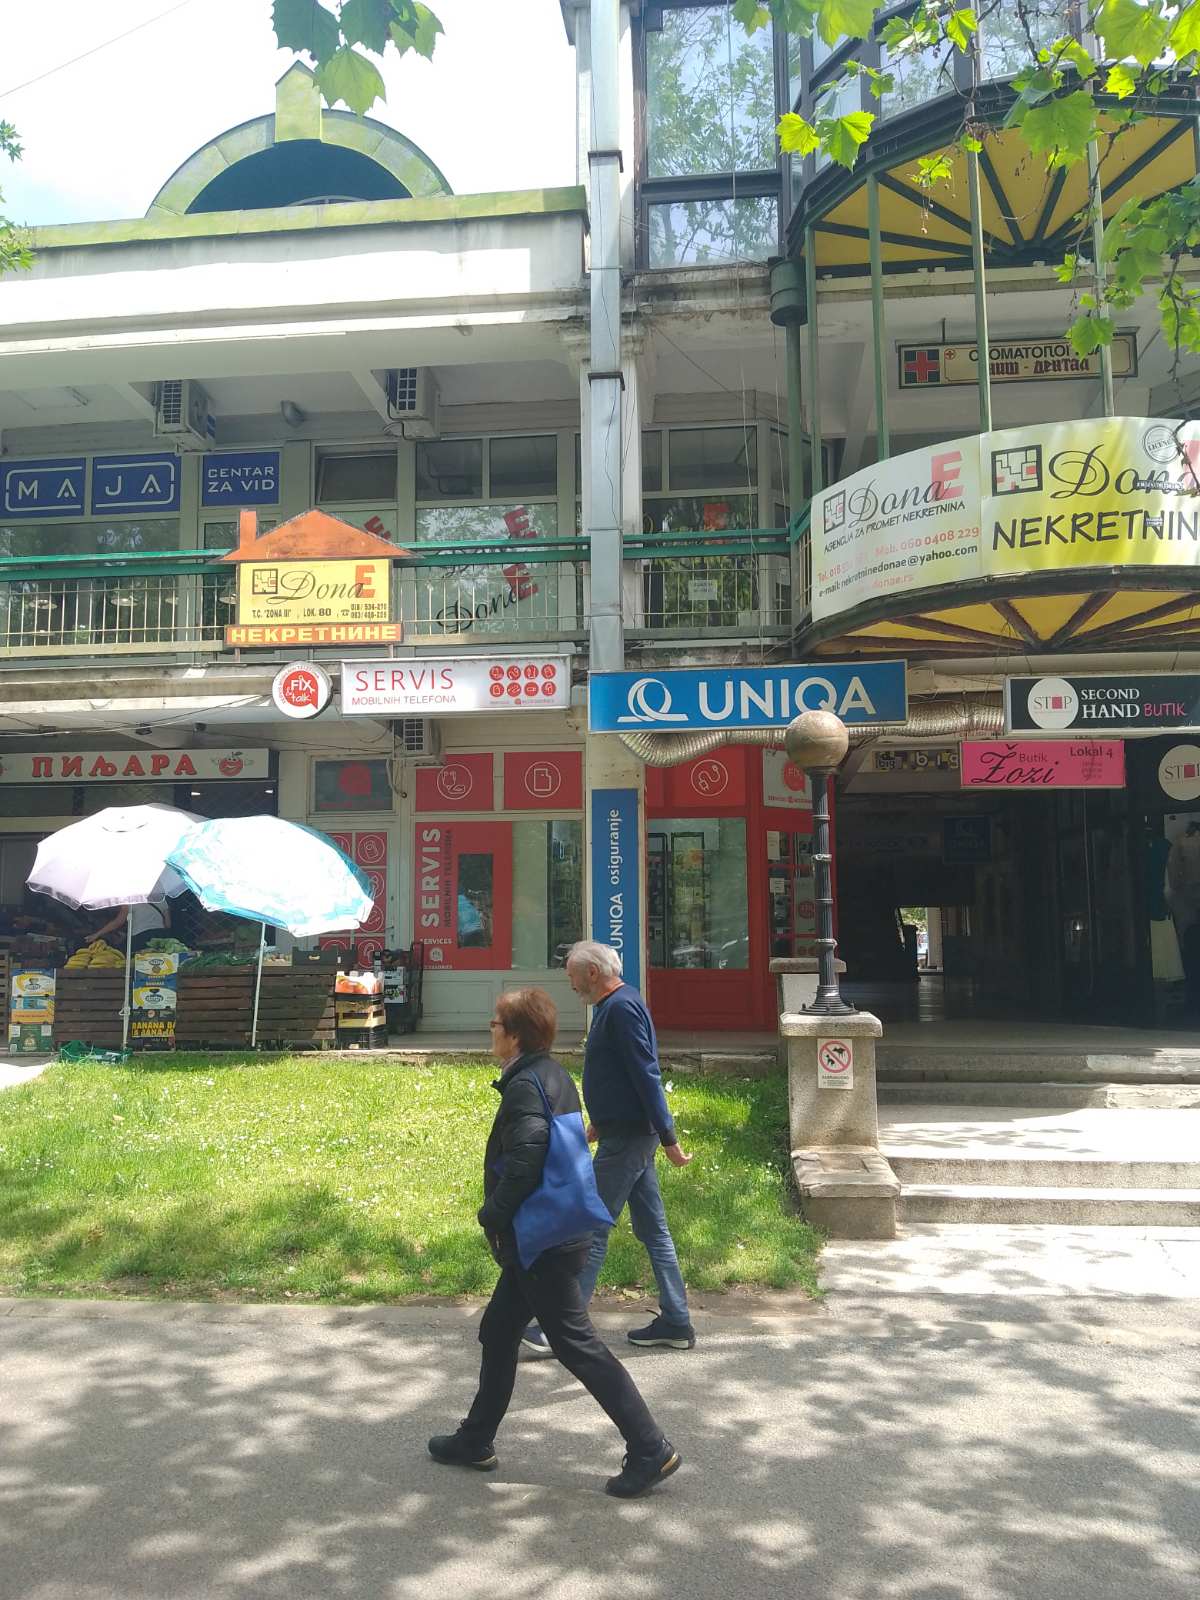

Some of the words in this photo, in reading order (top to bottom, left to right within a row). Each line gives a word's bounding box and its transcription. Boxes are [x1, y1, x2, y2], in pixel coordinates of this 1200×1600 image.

[969, 343, 1102, 362] СОМАТОЛОА
[208, 466, 275, 478] CENTAR
[208, 481, 233, 493] ZA
[241, 479, 275, 492] VID
[848, 479, 951, 528] Dona
[855, 527, 865, 539] ZA
[865, 513, 902, 537] PROMET
[902, 500, 965, 524] NEKRETNINA
[924, 530, 955, 547] 0408
[957, 527, 979, 541] 229
[266, 570, 364, 605] Dona
[355, 565, 375, 598] E
[318, 607, 332, 617] 80
[231, 625, 397, 642] НЕКРЕТНИНЕ
[291, 678, 315, 693] FIX
[356, 668, 454, 692] SERVIS
[352, 696, 401, 706] MOBILNIH
[404, 695, 456, 705] TELEFONA
[699, 676, 876, 721] UNIQA
[1033, 696, 1073, 710] STP
[1081, 688, 1140, 700] SECOND
[1082, 703, 1140, 719] HAND
[1143, 703, 1187, 717] BUTIK
[1018, 752, 1048, 763] Butik
[1070, 745, 1103, 757] Lokal
[31, 754, 197, 778] ПИЉАРА
[1164, 763, 1200, 780] ST
[607, 809, 623, 885] osiguranje
[421, 828, 441, 928] SERVIS
[609, 892, 624, 950] UNIQA
